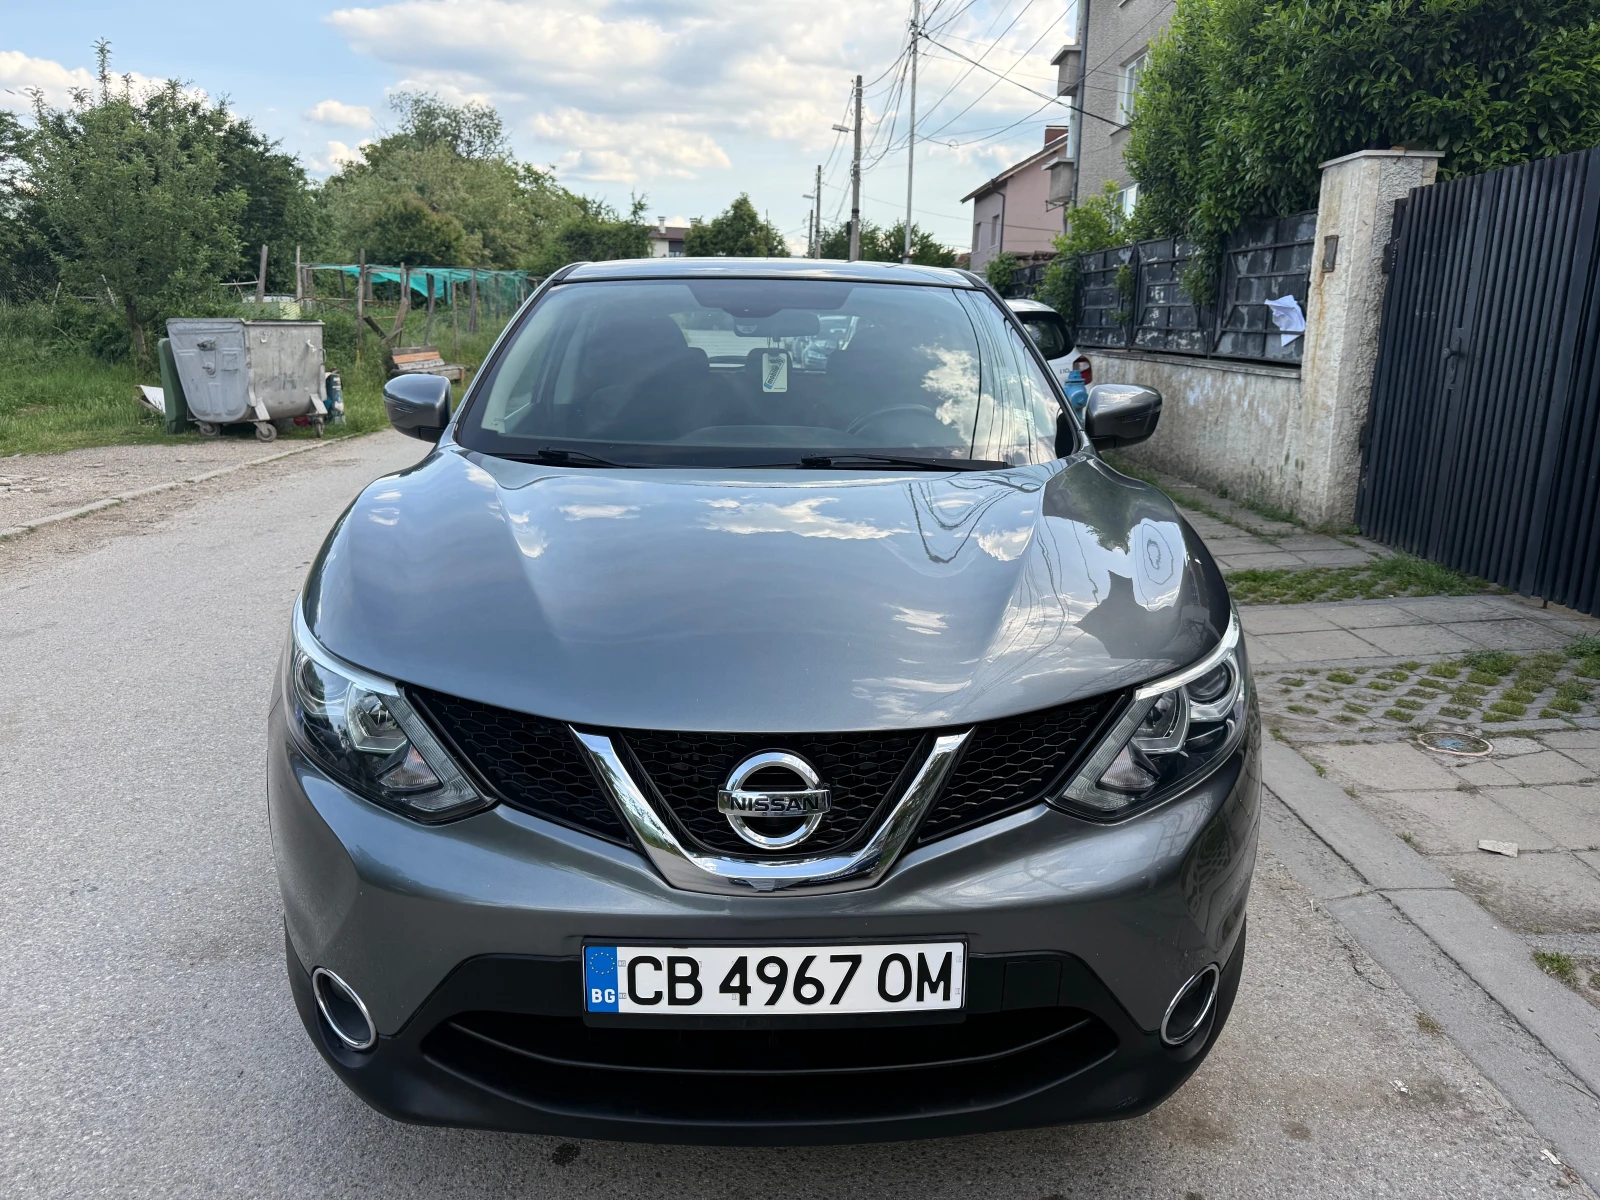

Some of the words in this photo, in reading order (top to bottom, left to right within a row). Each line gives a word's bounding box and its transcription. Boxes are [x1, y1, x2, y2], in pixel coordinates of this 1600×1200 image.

[730, 796, 819, 812] NISSAN
[627, 955, 703, 1006] CB
[719, 954, 862, 1006] 4967
[877, 951, 953, 1003] OM
[591, 988, 616, 1004] BG
